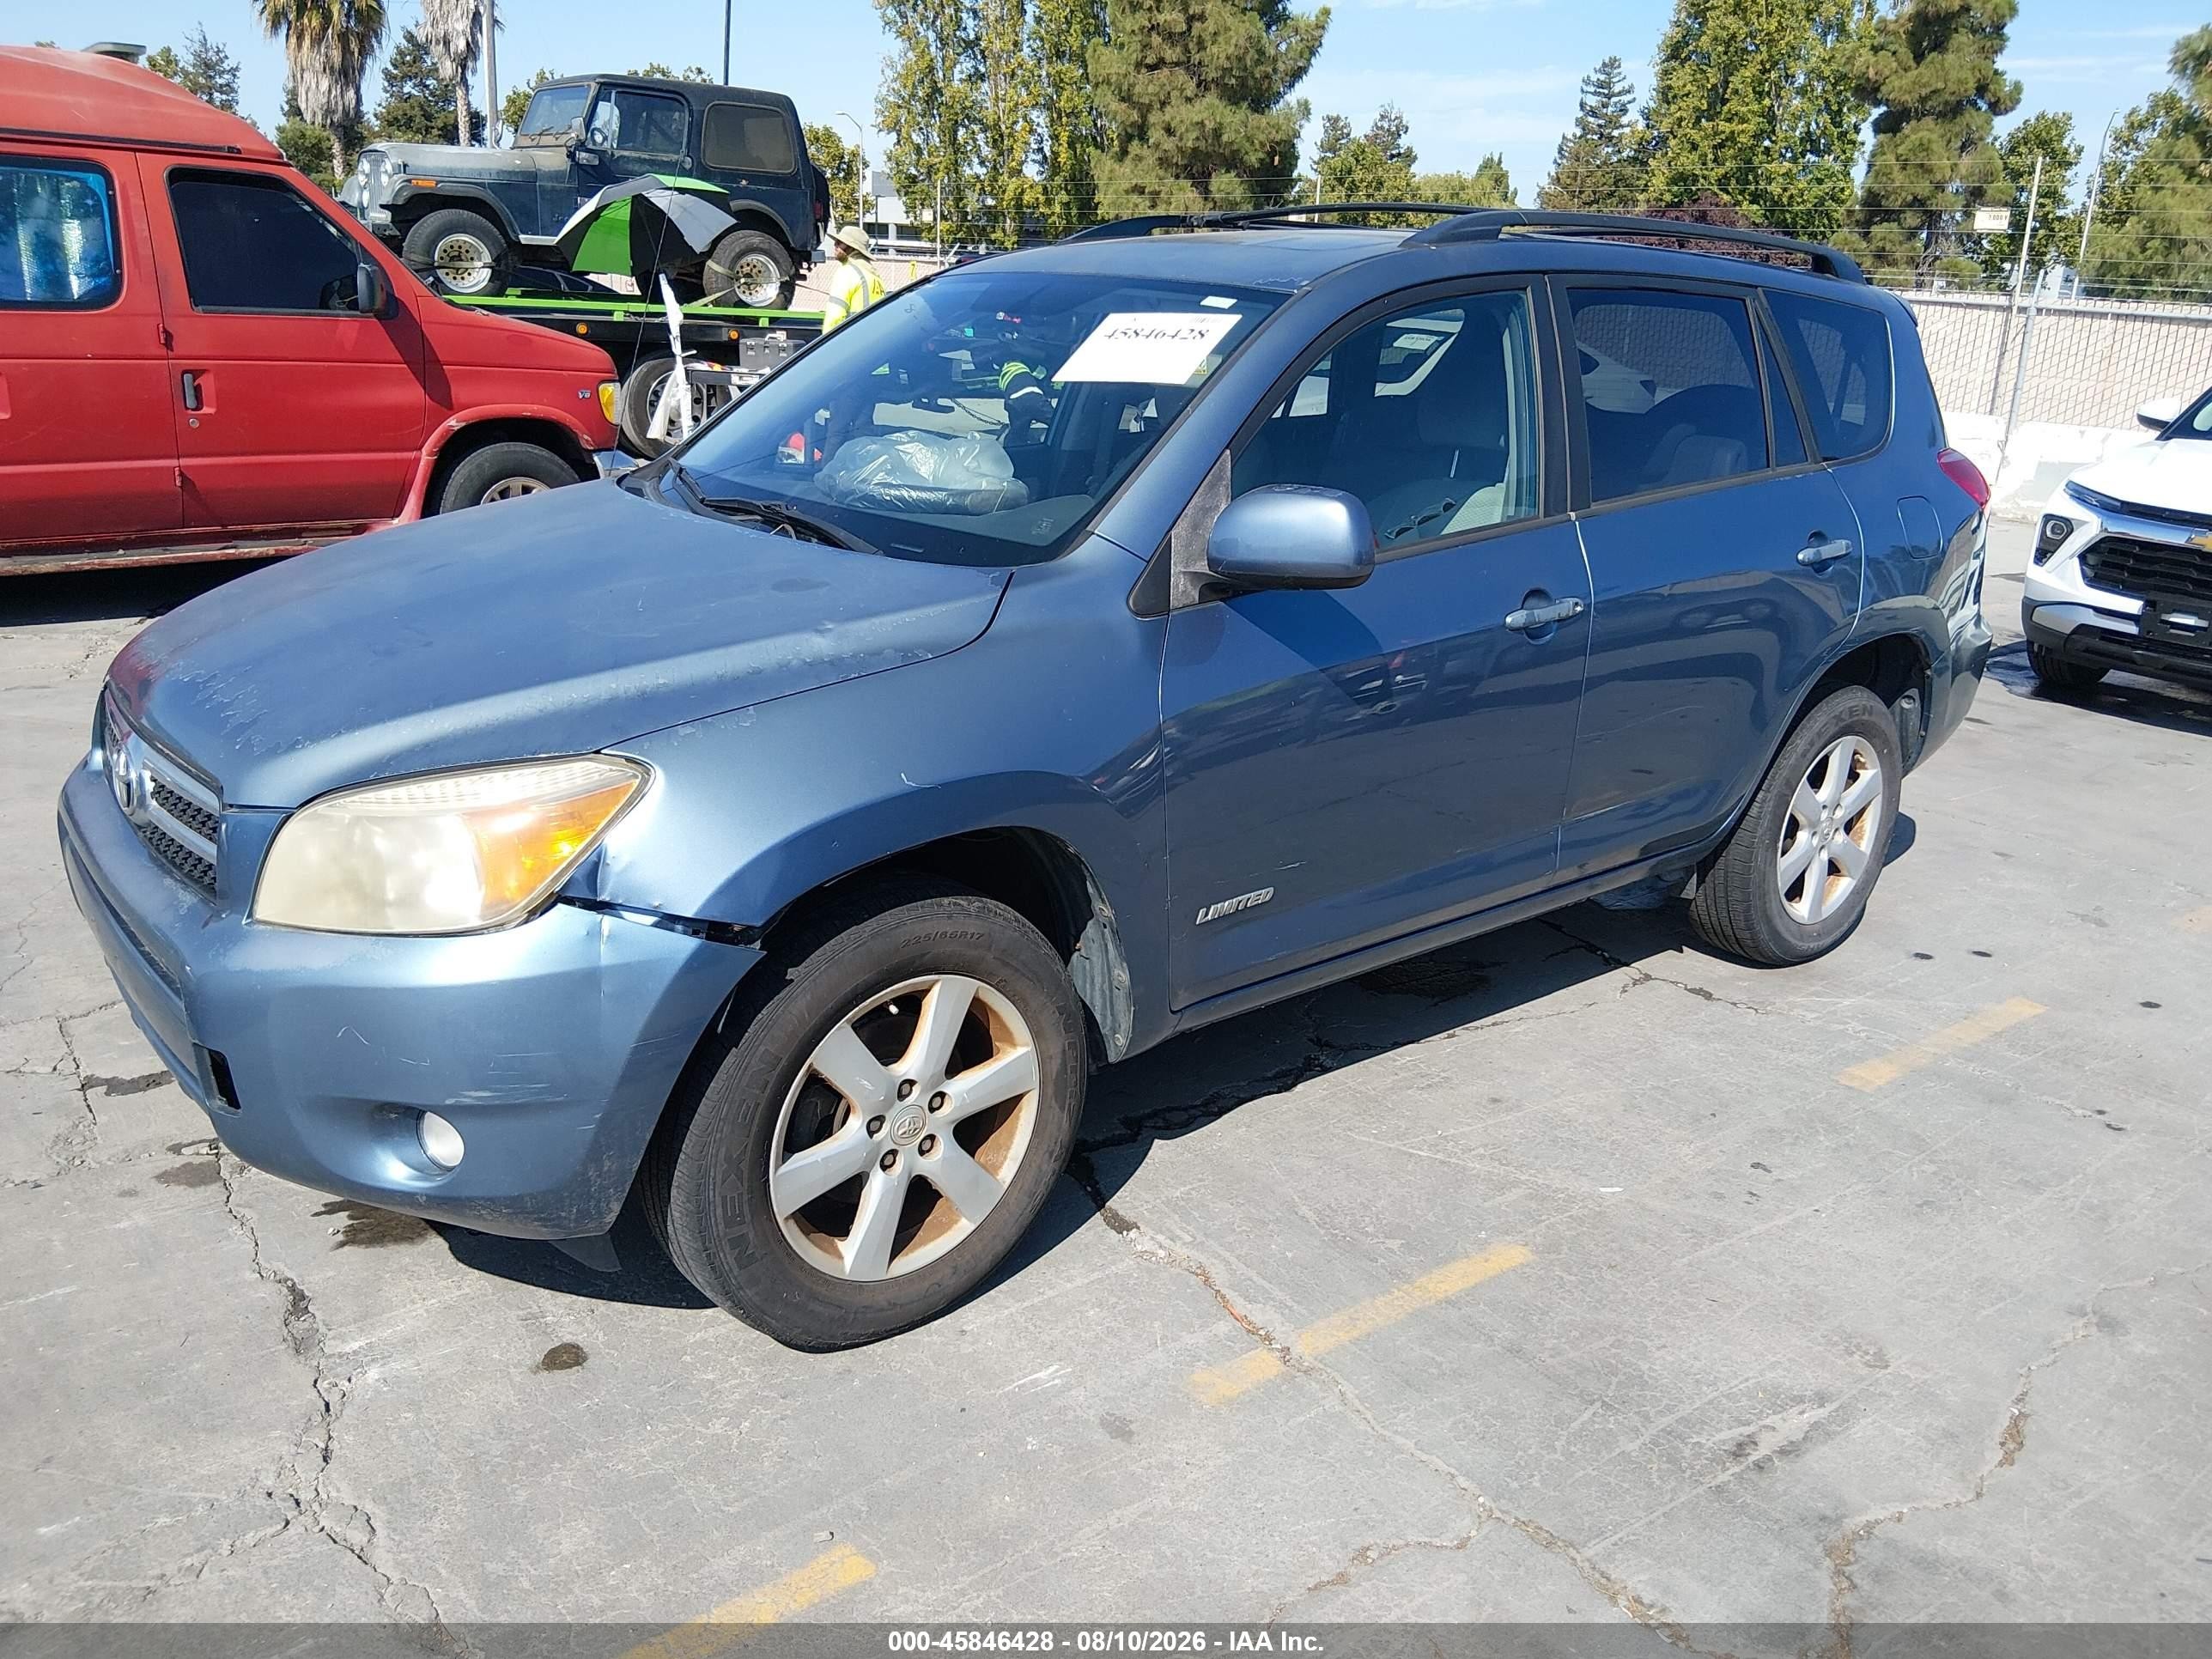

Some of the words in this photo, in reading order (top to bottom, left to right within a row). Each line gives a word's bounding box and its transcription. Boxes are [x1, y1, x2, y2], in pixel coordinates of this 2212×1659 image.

[1104, 328, 1210, 340] 45846428
[1195, 886, 1275, 926] LIMITED
[899, 930, 985, 949] 225/65R17
[719, 1048, 784, 1272] NEXEN
